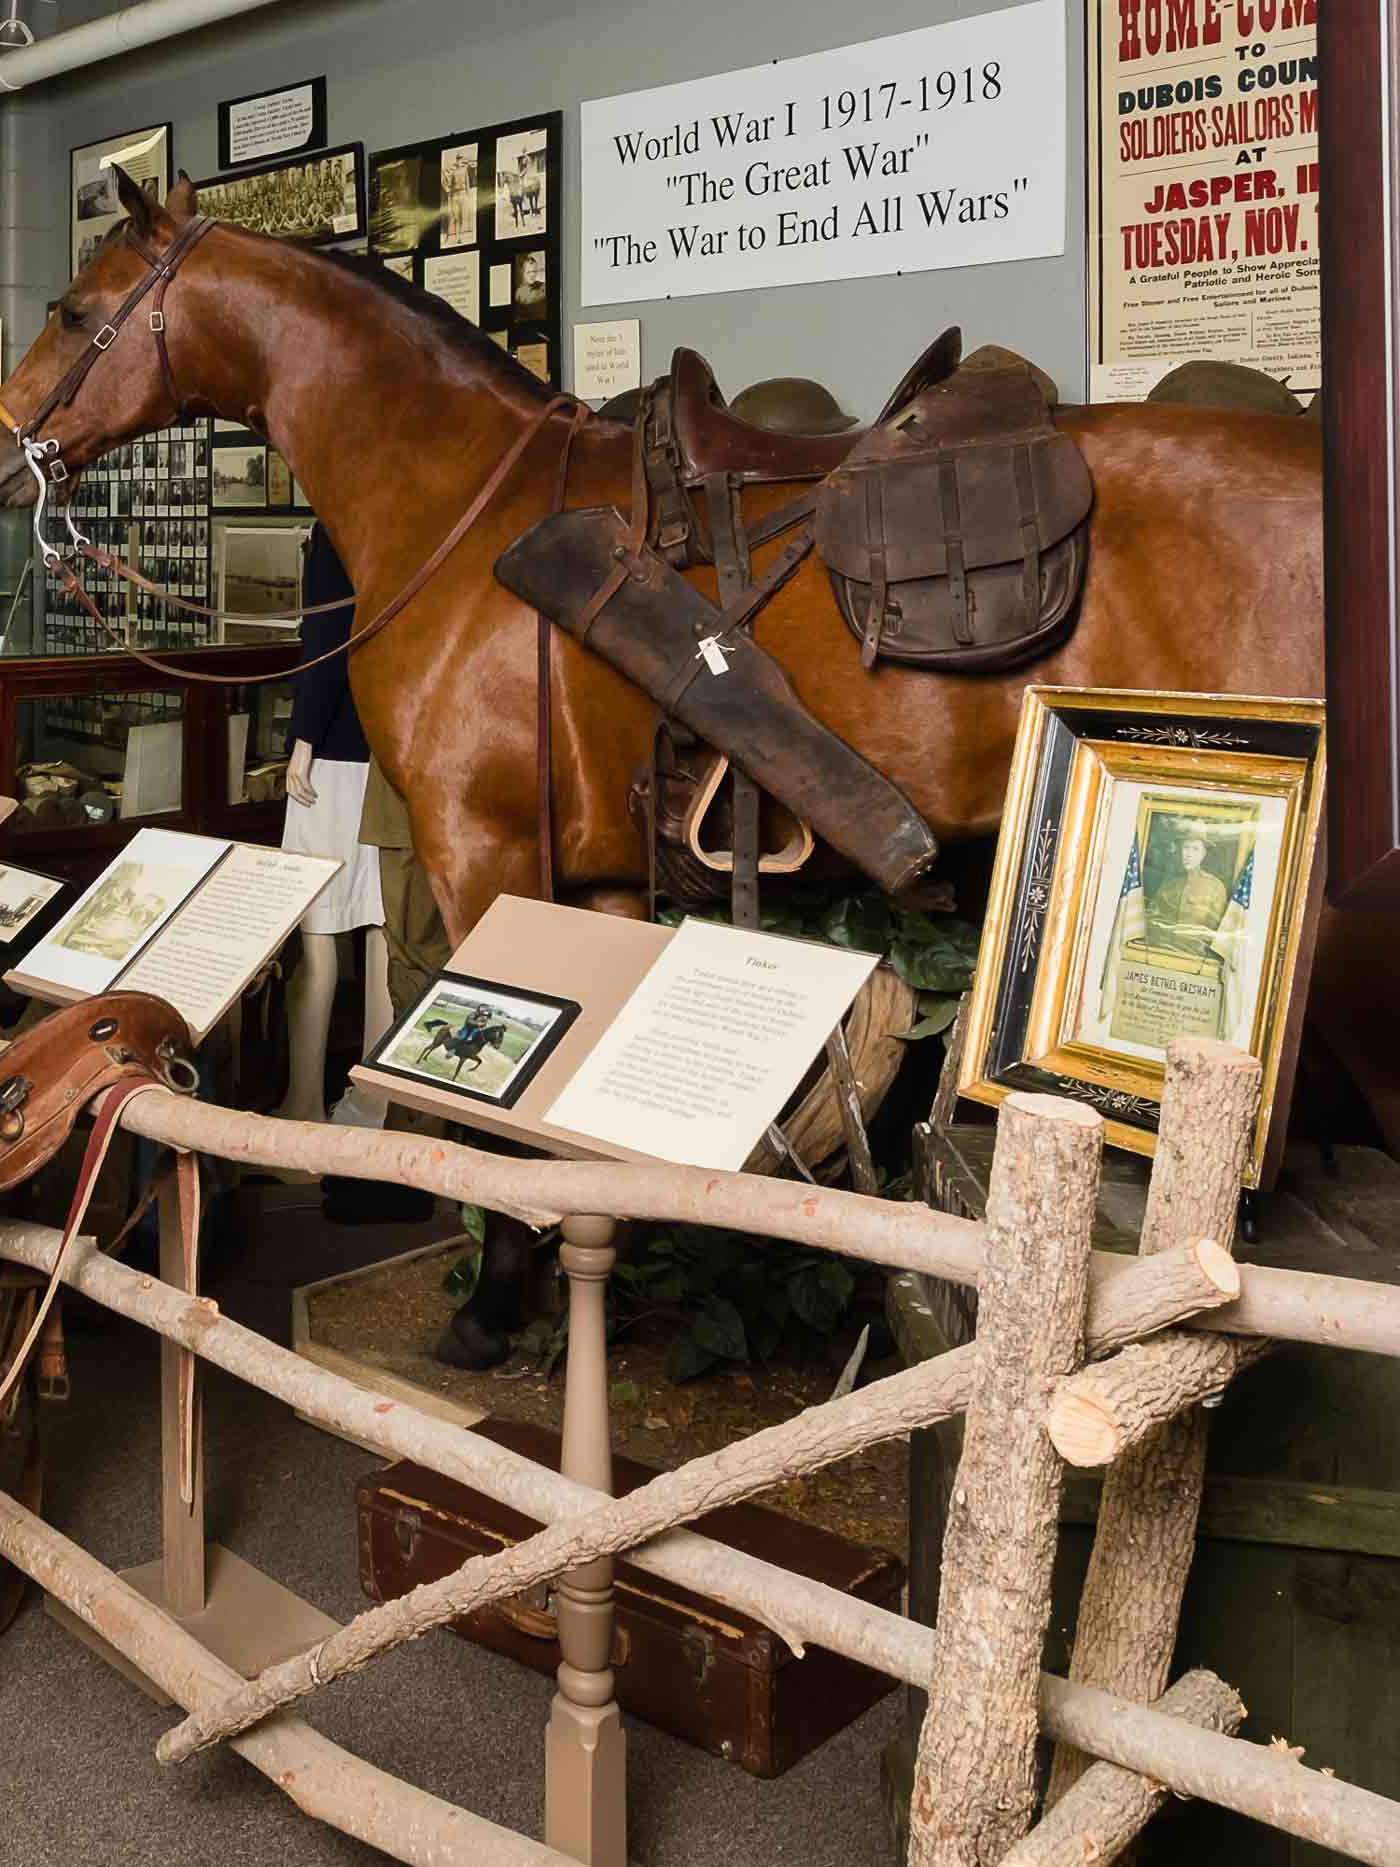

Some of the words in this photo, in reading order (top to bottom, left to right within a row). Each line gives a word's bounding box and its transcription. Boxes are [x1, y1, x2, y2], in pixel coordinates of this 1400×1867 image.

[1235, 43, 1265, 60] TO
[613, 120, 700, 165] World
[711, 112, 775, 148] War
[784, 102, 797, 137] I
[821, 61, 1001, 130] 1917-1918
[1118, 75, 1222, 115] DUBOIS
[666, 171, 735, 207] "The
[745, 156, 831, 196] Great
[842, 133, 929, 181] War"
[1235, 147, 1266, 165] AT
[1144, 169, 1285, 214] JASPER,
[594, 233, 657, 268] "The
[667, 224, 728, 259] War
[737, 224, 766, 251] to
[777, 205, 839, 248] End
[851, 196, 904, 238] All
[917, 177, 1028, 230] Wars"
[1120, 212, 1238, 271] TUESDAY,
[1245, 203, 1307, 257] NOV.
[1129, 276, 1137, 285] A
[1140, 271, 1179, 284] Grateful
[1184, 268, 1218, 279] People
[1223, 267, 1232, 275] to
[1237, 263, 1266, 273] Show
[1184, 277, 1228, 289] Patriotic
[1232, 275, 1251, 284] and
[1256, 271, 1291, 281] Heroic
[1125, 970, 1148, 984] JAMES
[1180, 981, 1216, 999] GRESHAM
